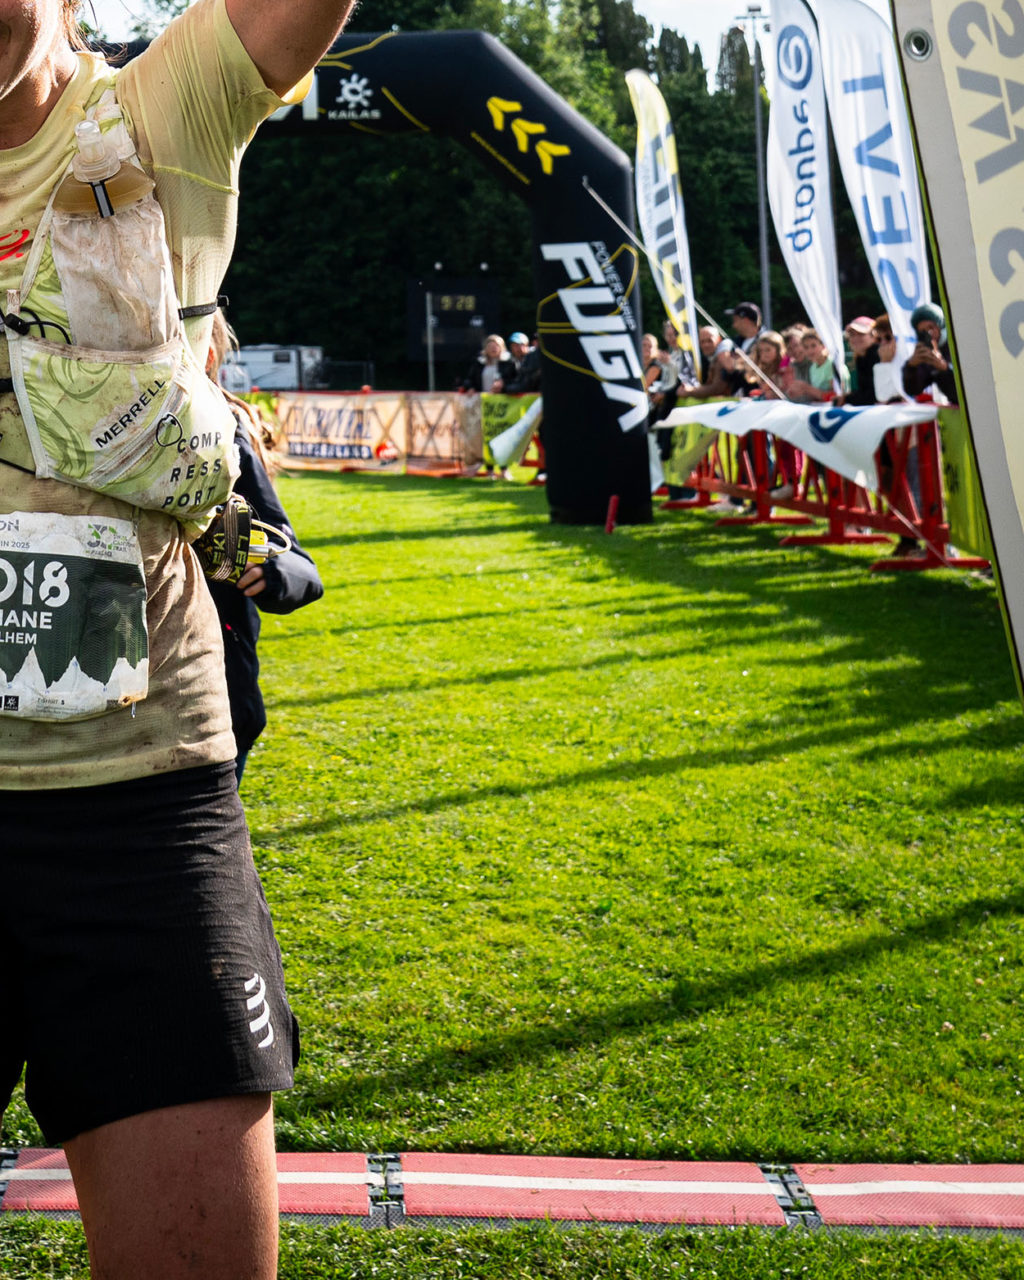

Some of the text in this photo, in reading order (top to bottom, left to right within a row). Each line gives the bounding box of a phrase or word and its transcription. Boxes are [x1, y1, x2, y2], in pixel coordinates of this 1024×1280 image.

[328, 109, 381, 120] KAILAS
[540, 242, 649, 433] FUGA
[95, 379, 165, 449] MERRELL
[177, 432, 222, 453] COMP
[170, 459, 222, 483] RESS
[162, 486, 215, 509] PORT
[11, 541, 31, 549] 2025
[227, 535, 249, 584] LEKI
